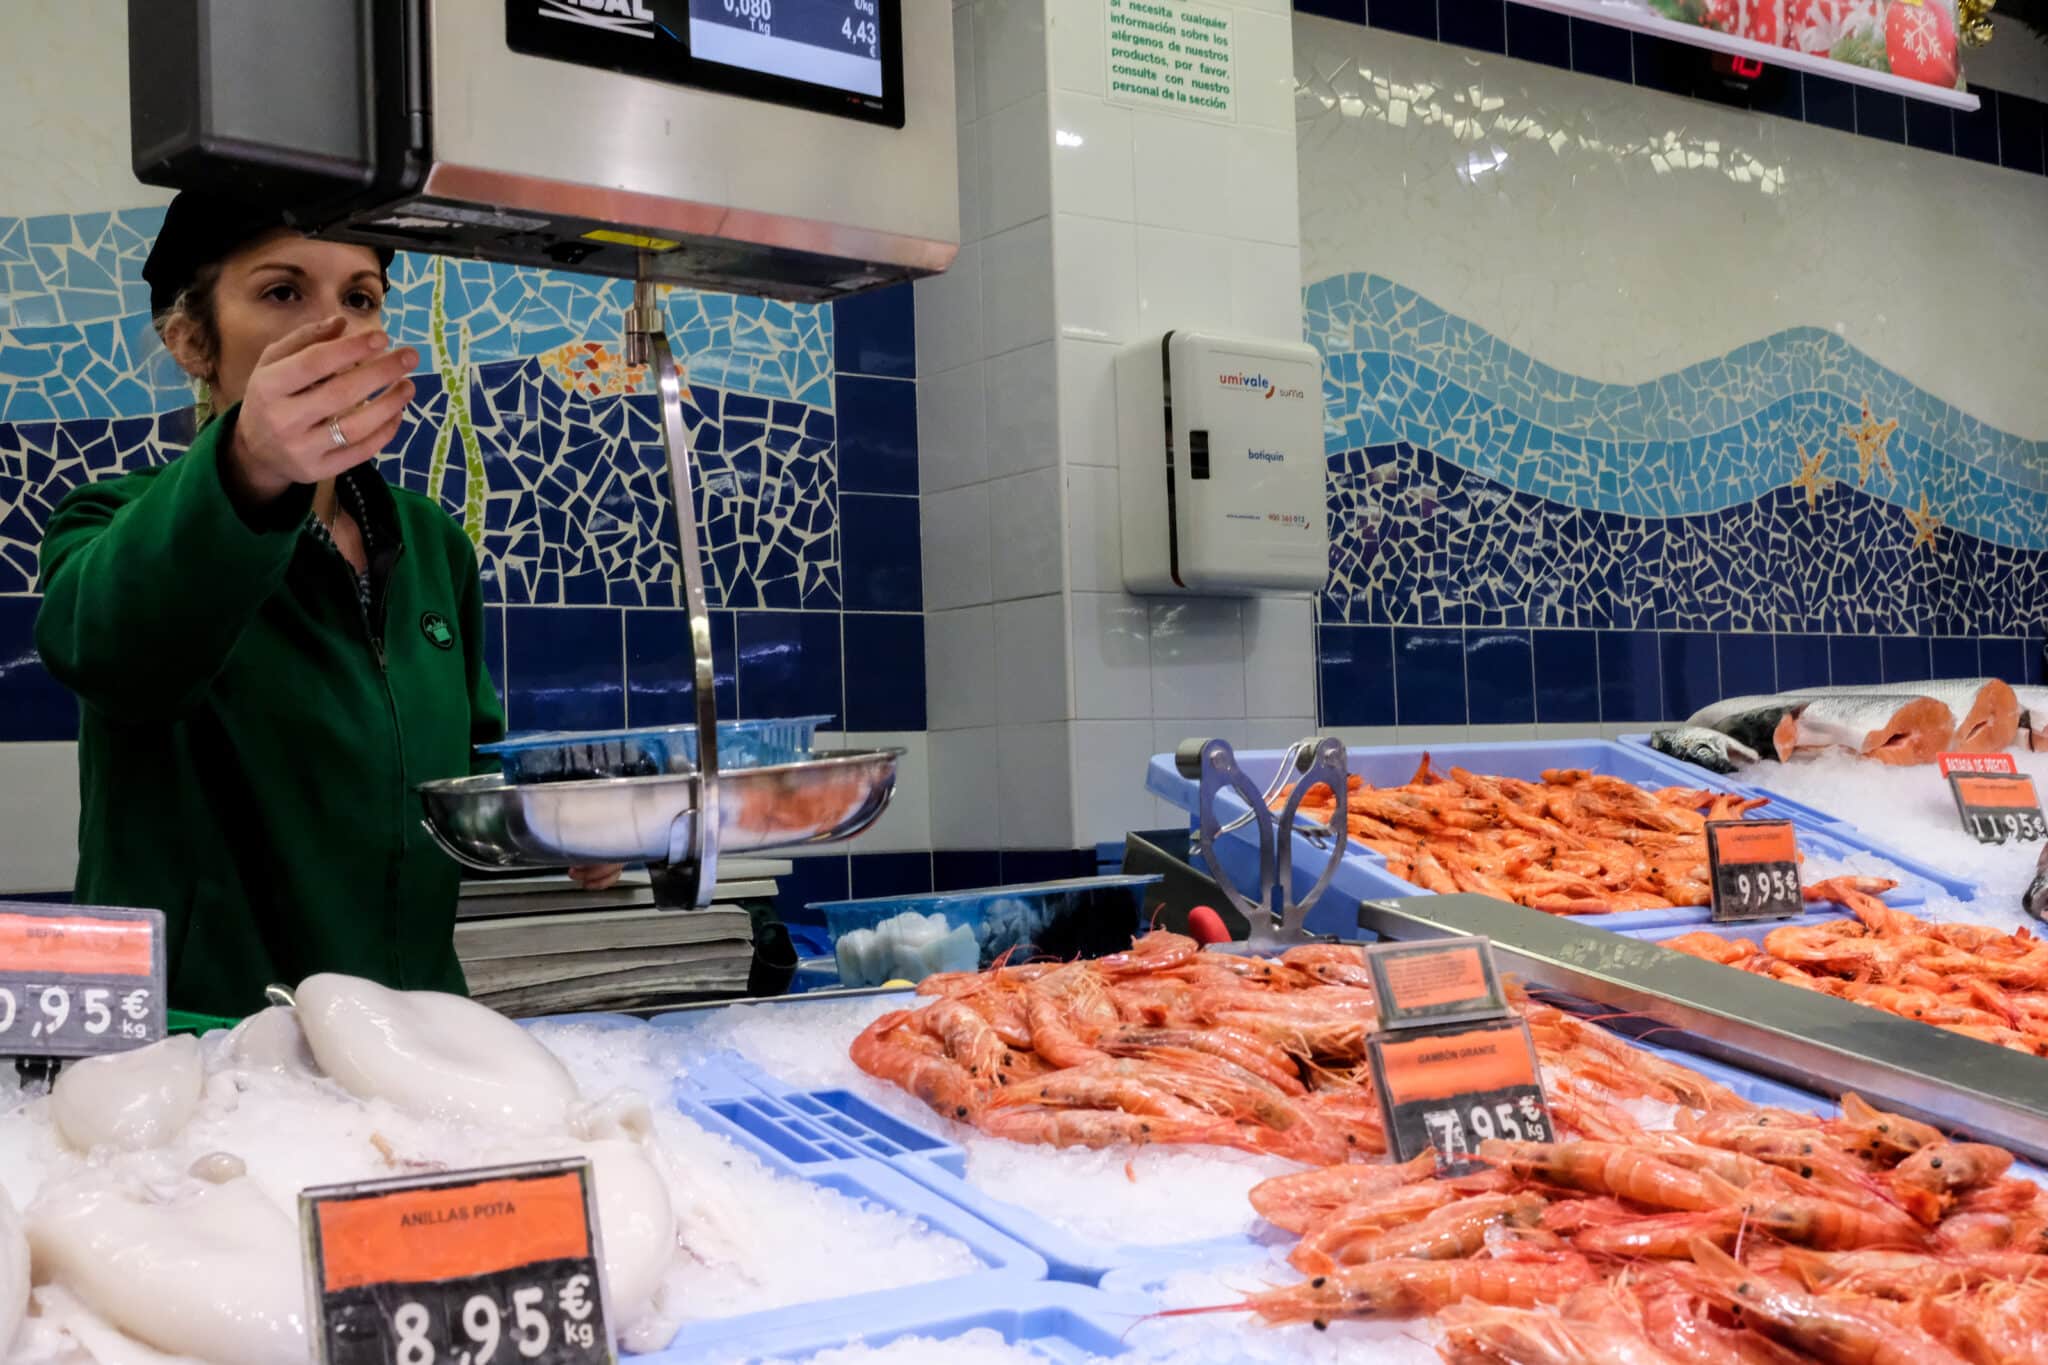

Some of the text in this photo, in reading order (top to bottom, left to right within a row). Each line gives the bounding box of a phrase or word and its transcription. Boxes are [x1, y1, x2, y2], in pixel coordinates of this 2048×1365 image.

[758, 20, 771, 36] kg
[1129, 0, 1173, 18] necesita
[1181, 12, 1227, 29] cualquier
[841, 16, 877, 45] 4,43
[1110, 12, 1229, 47] información sobre los
[1112, 30, 1229, 63] alérgenos de nuestros
[1112, 47, 1169, 69] productos,
[1175, 60, 1193, 71] por
[1112, 64, 1230, 95] consulte con nuestro
[1112, 81, 1227, 110] personal de la sección
[1219, 372, 1269, 389] umivale
[1738, 870, 1785, 906] 9,95
[121, 988, 149, 1020] €
[122, 1018, 147, 1039] kg
[1526, 1120, 1545, 1141] kg
[400, 1201, 516, 1228] ANILLAS POTA
[558, 1273, 594, 1320] €
[563, 1319, 595, 1348] kg
